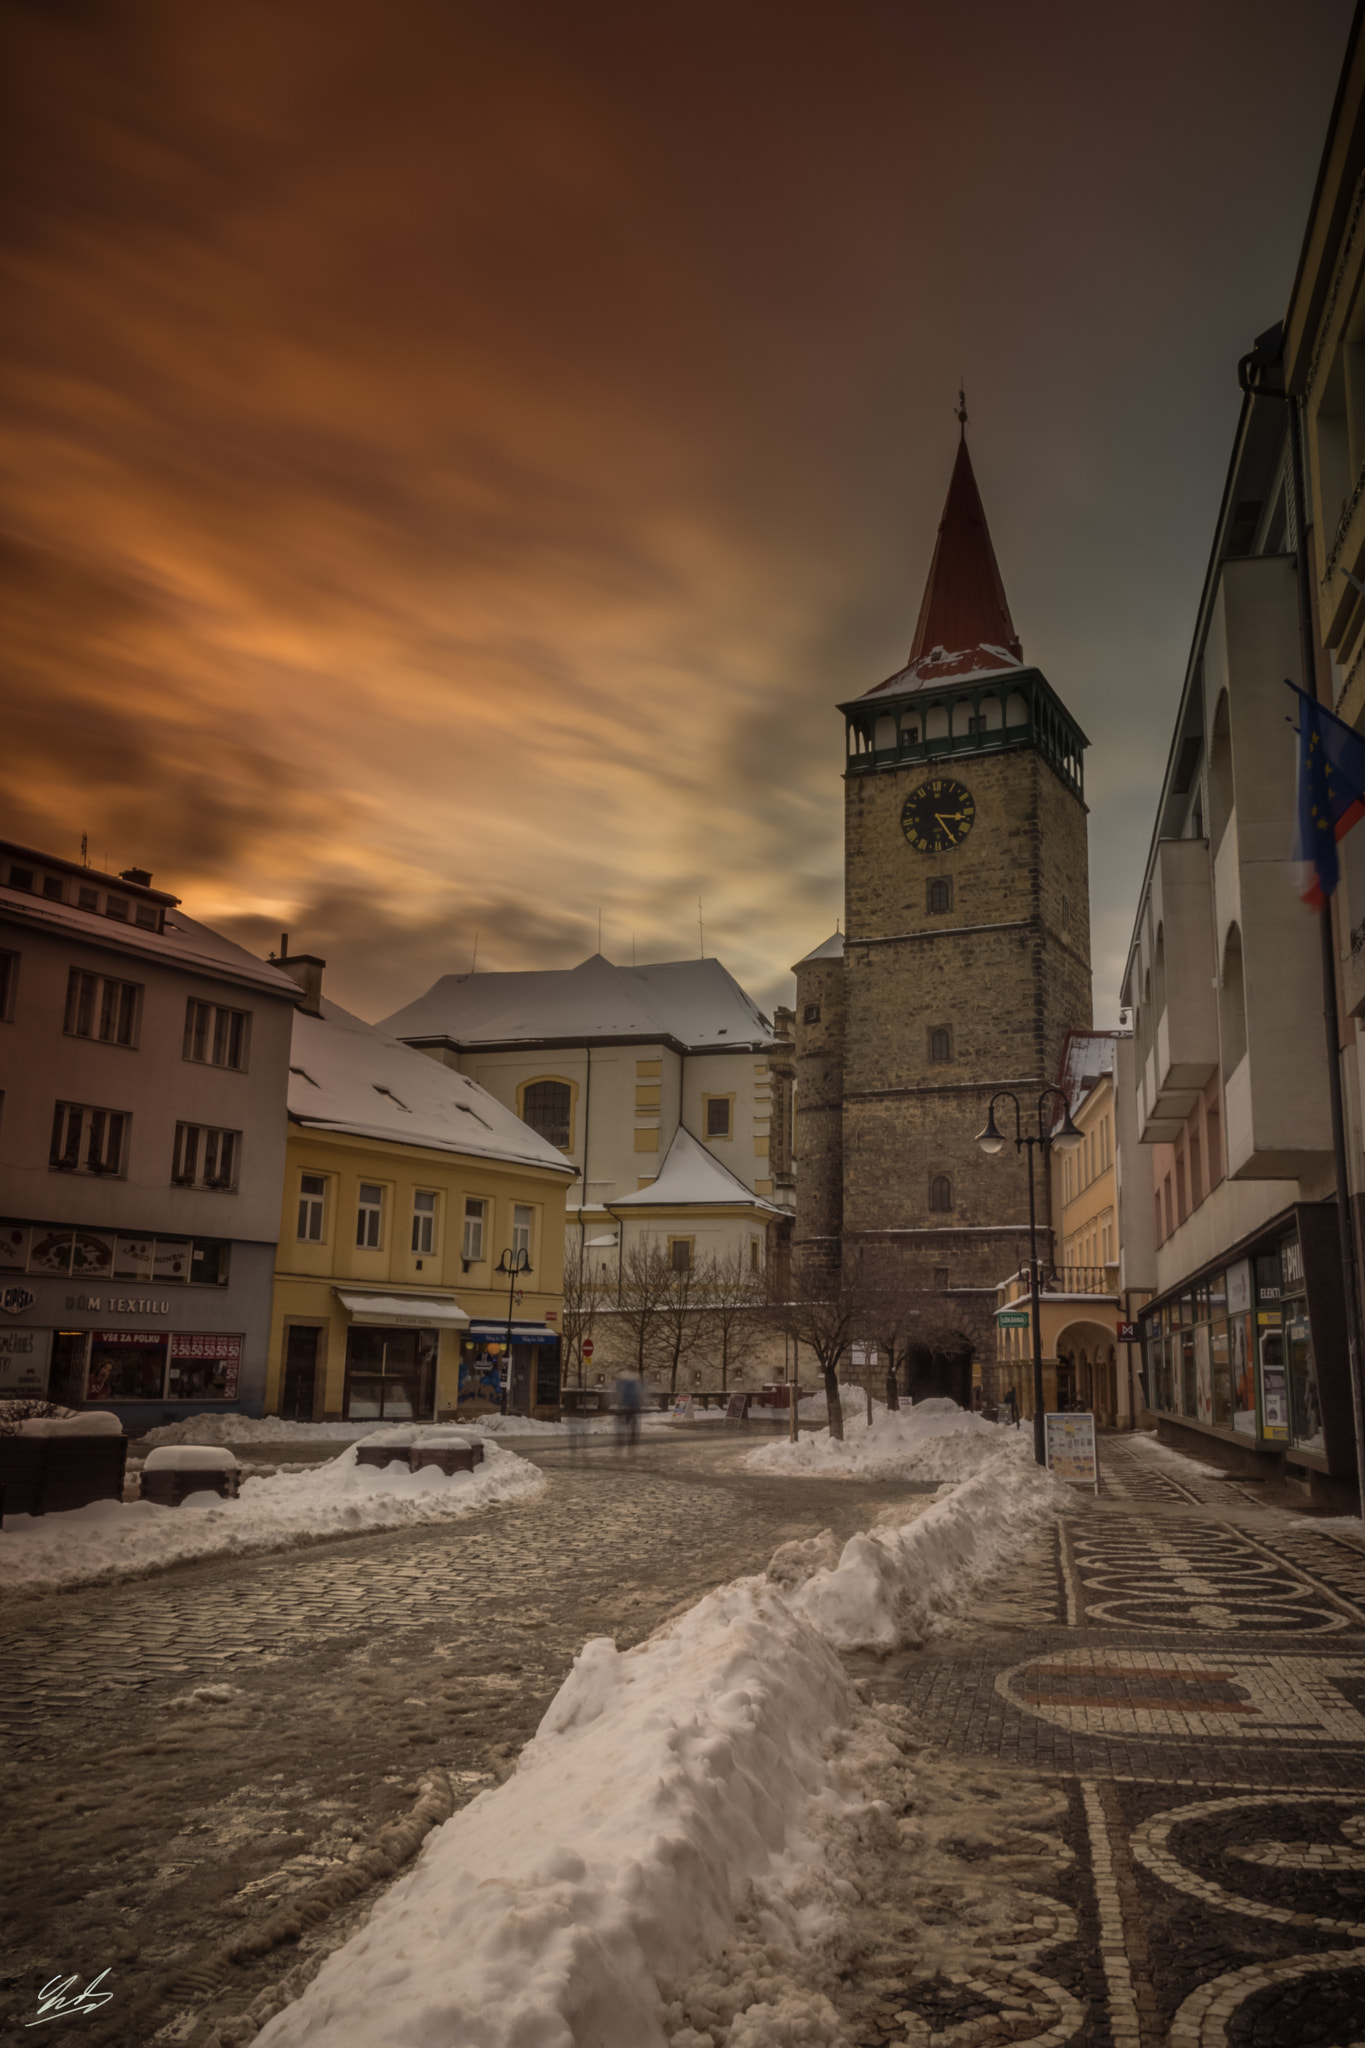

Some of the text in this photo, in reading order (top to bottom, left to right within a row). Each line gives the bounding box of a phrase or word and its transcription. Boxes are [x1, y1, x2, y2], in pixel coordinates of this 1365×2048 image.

[109, 1297, 170, 1314] TEXTILU
[102, 1333, 118, 1342] VŠE
[120, 1334, 132, 1342] ZA
[226, 1369, 238, 1379] 50
